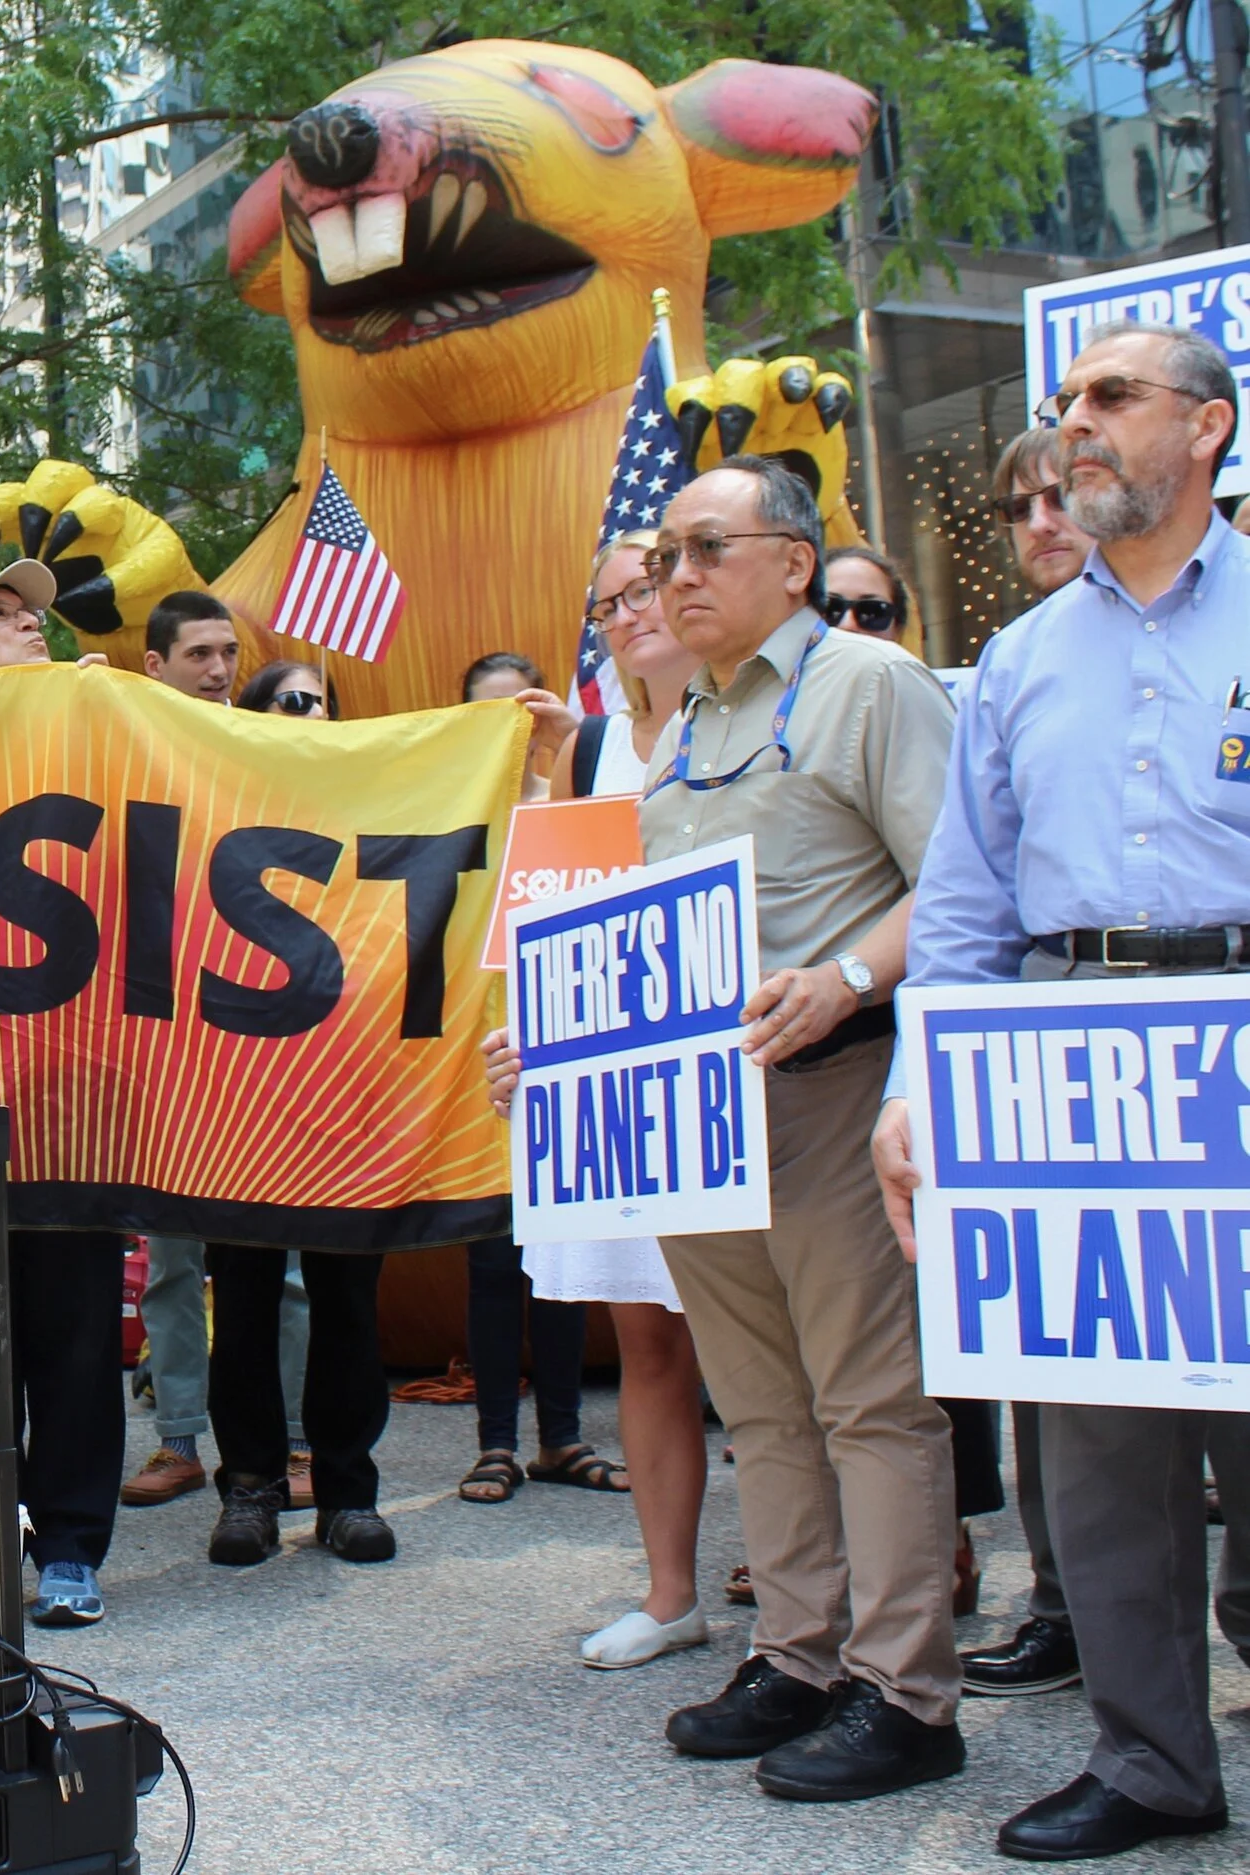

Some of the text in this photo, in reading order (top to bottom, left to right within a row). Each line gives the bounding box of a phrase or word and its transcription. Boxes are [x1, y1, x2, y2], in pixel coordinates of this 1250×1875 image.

[508, 865, 643, 901] SOLID
[520, 883, 738, 1048] THERE'S NO
[525, 1046, 746, 1207] PLANET B!
[951, 1208, 1250, 1364] PLANE
